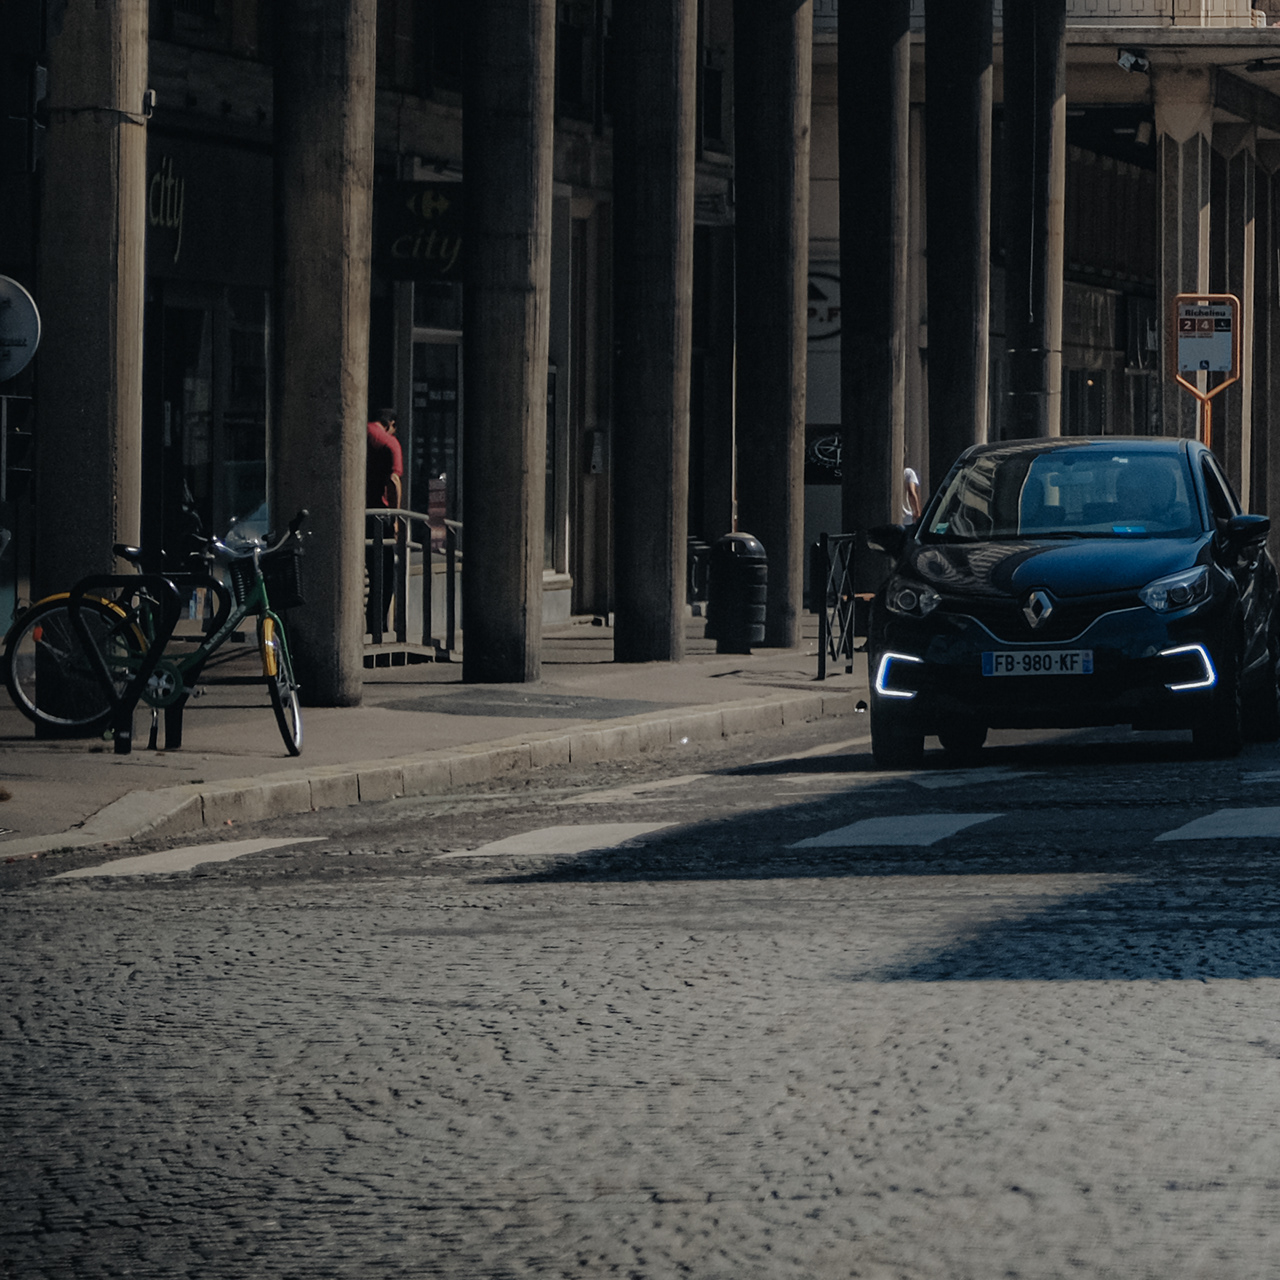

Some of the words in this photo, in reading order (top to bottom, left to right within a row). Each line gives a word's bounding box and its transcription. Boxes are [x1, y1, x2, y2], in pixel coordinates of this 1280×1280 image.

[150, 154, 185, 264] city
[390, 228, 463, 272] city
[1185, 309, 1226, 317] Richelieu
[1183, 320, 1192, 330] 2
[1200, 320, 1210, 330] 4
[994, 652, 1080, 673] FB-980-KF
